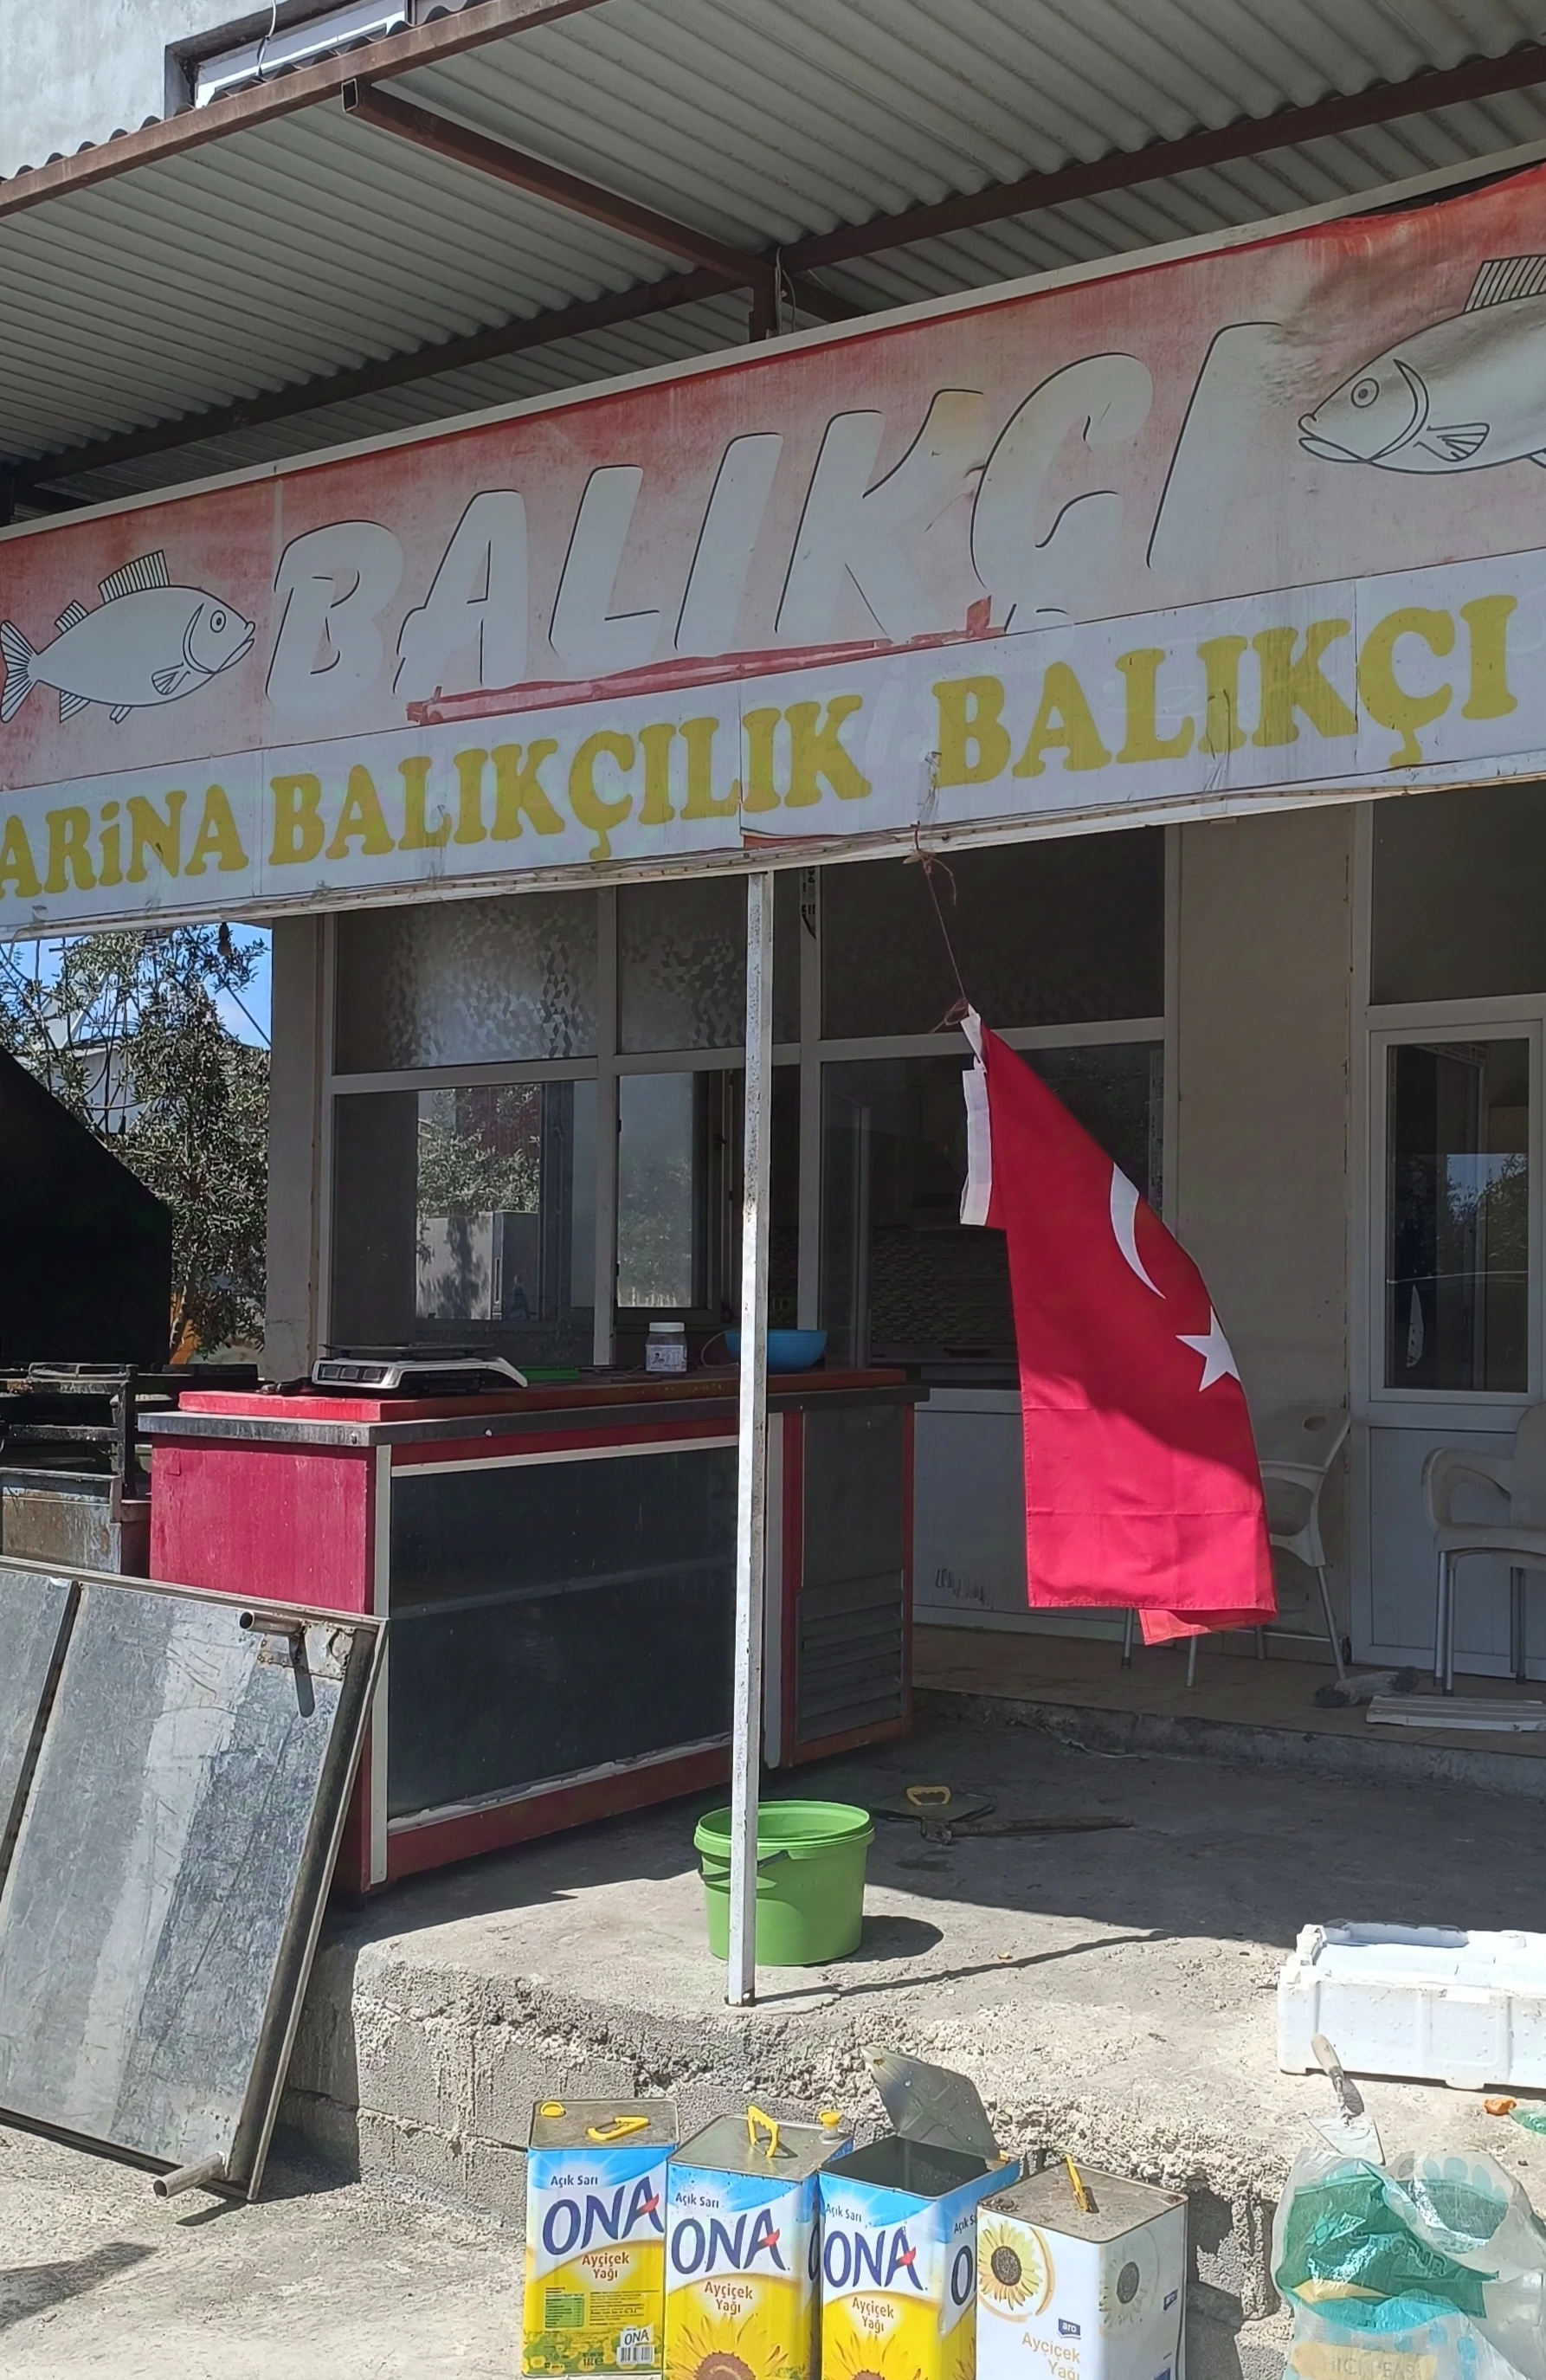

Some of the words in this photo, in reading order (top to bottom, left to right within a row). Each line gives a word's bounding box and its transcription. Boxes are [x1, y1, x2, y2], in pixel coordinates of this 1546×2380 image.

[268, 693, 873, 861] BALIKÇILIK
[931, 594, 1519, 790] BALIKÇI
[551, 2174, 574, 2190] Açık
[577, 2174, 598, 2186] Sarı
[676, 2192, 697, 2206] Açık
[699, 2197, 719, 2209] Sarı
[543, 2176, 665, 2255] ONA
[825, 2203, 844, 2217] Açık
[845, 2209, 862, 2222] Sarı
[954, 2217, 969, 2235] Açık
[671, 2208, 787, 2274] ONA
[581, 2251, 630, 2271] Ayçiçek
[823, 2225, 924, 2291] ONA
[592, 2267, 618, 2280] Yağı
[704, 2280, 754, 2302] Ayçiçek
[715, 2298, 742, 2314] Yağı
[852, 2296, 895, 2321] Ayçiçek
[860, 2313, 885, 2334] Yağı
[1062, 2322, 1077, 2333] aro
[624, 2330, 649, 2345] ONA
[1021, 2332, 1080, 2364] Ayçiçek
